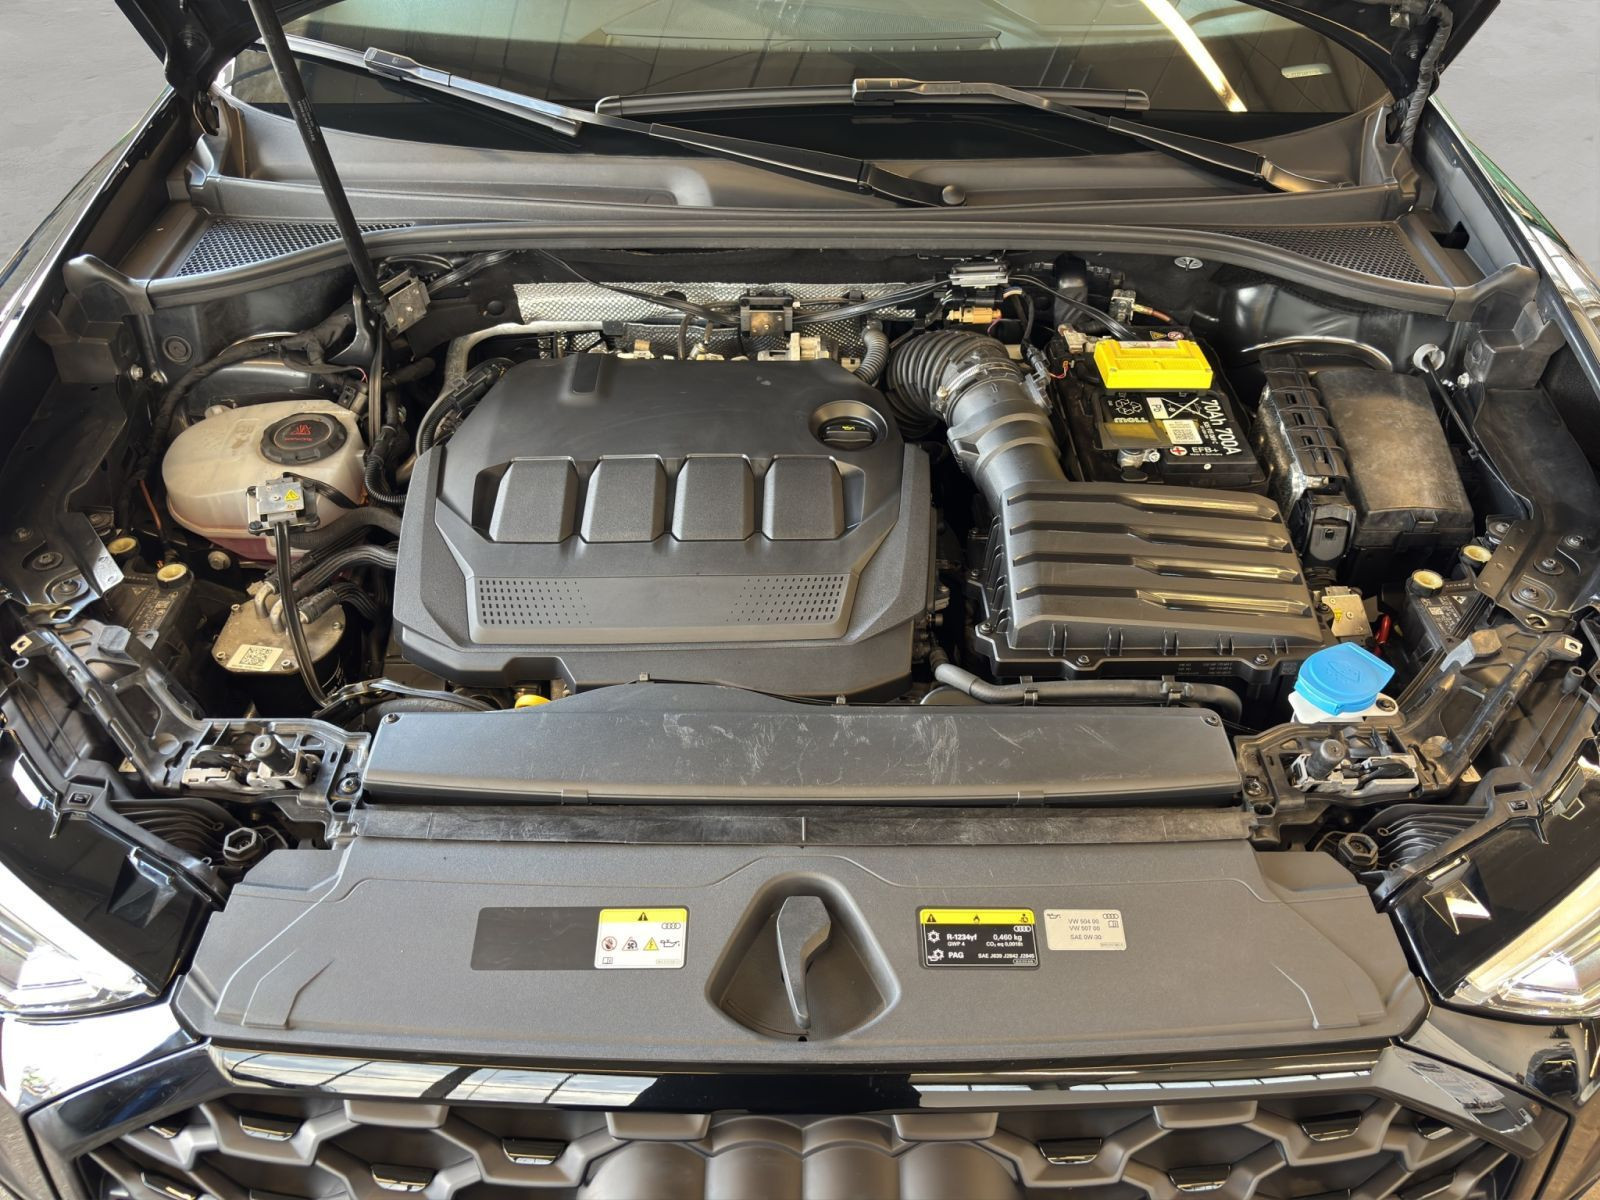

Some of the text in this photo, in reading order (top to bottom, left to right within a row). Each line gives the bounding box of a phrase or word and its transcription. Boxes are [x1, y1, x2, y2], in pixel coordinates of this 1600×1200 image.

[1201, 400, 1227, 425] 70Ah
[1215, 428, 1242, 455] 700A
[993, 933, 1022, 941] 0,460 kg
[948, 951, 964, 959] PAG
